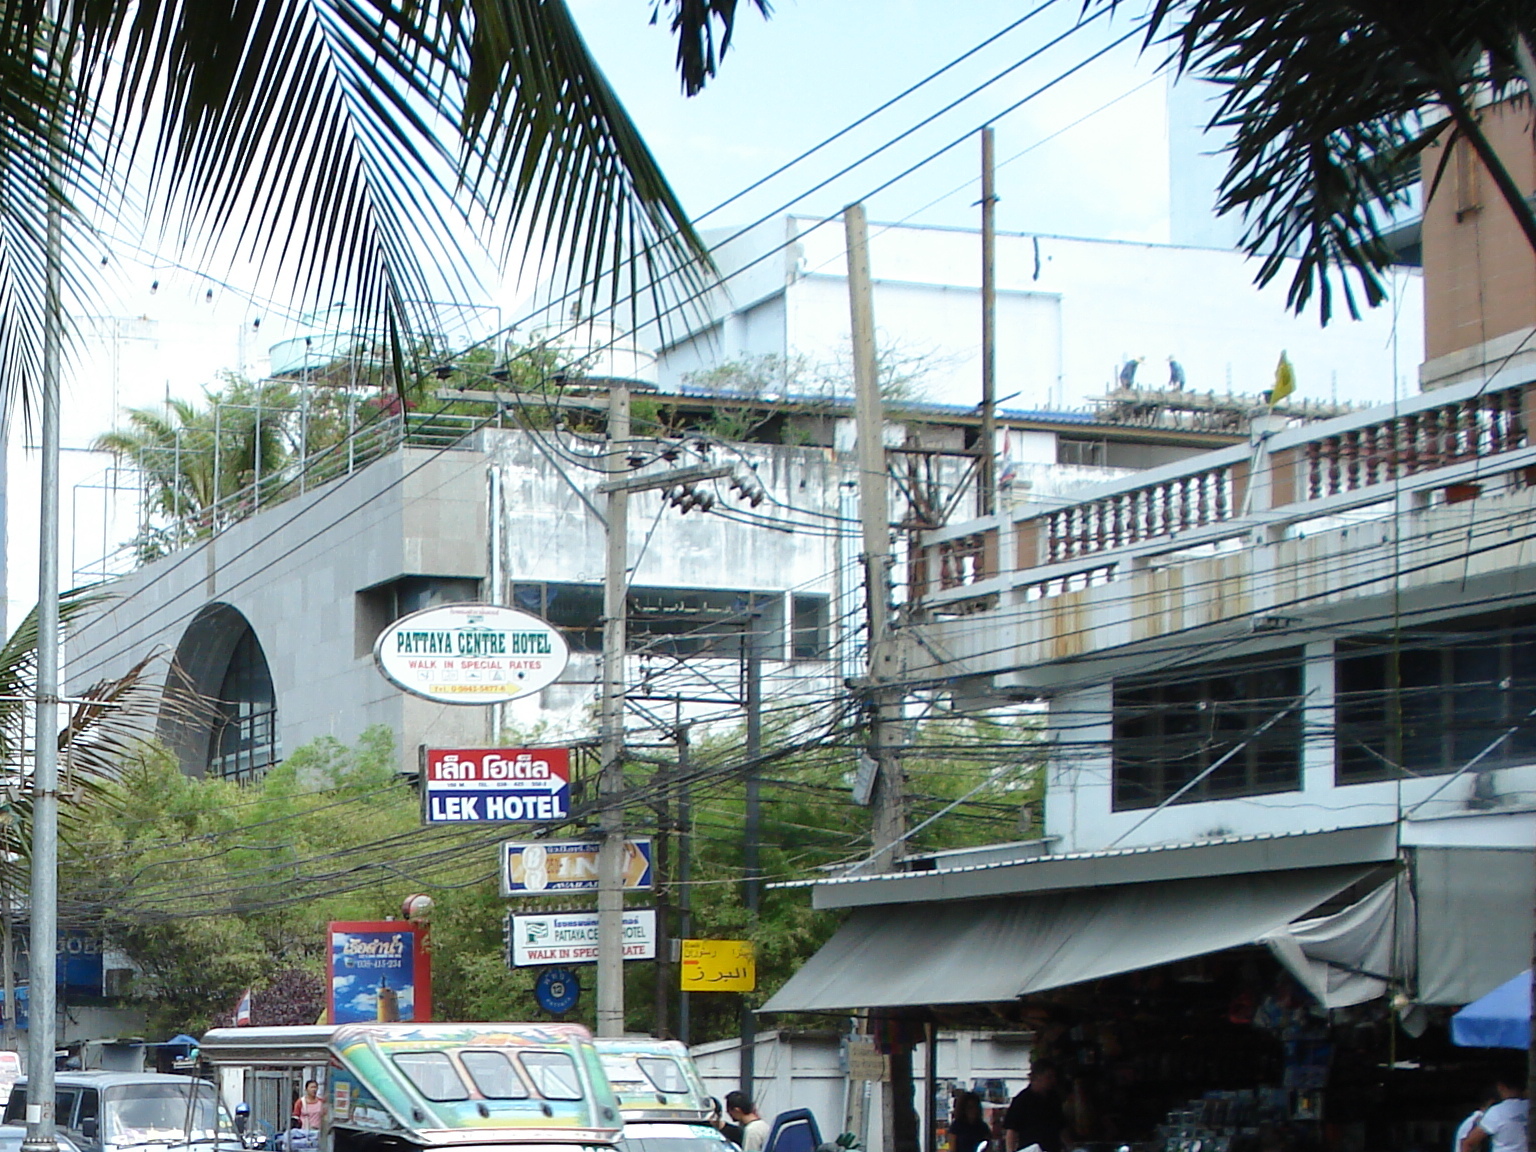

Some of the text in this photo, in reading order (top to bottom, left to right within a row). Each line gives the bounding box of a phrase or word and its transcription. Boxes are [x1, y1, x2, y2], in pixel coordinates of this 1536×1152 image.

[396, 631, 552, 655] PATTAYA CENTRE HOTEL
[408, 660, 542, 669] WALK IN SPECIAL RATES
[435, 754, 476, 779] เล็ก
[431, 795, 567, 821] LEK HOTEL
[555, 929, 585, 941] PATTAYA
[527, 949, 557, 959] WALK
[559, 948, 570, 958] IN
